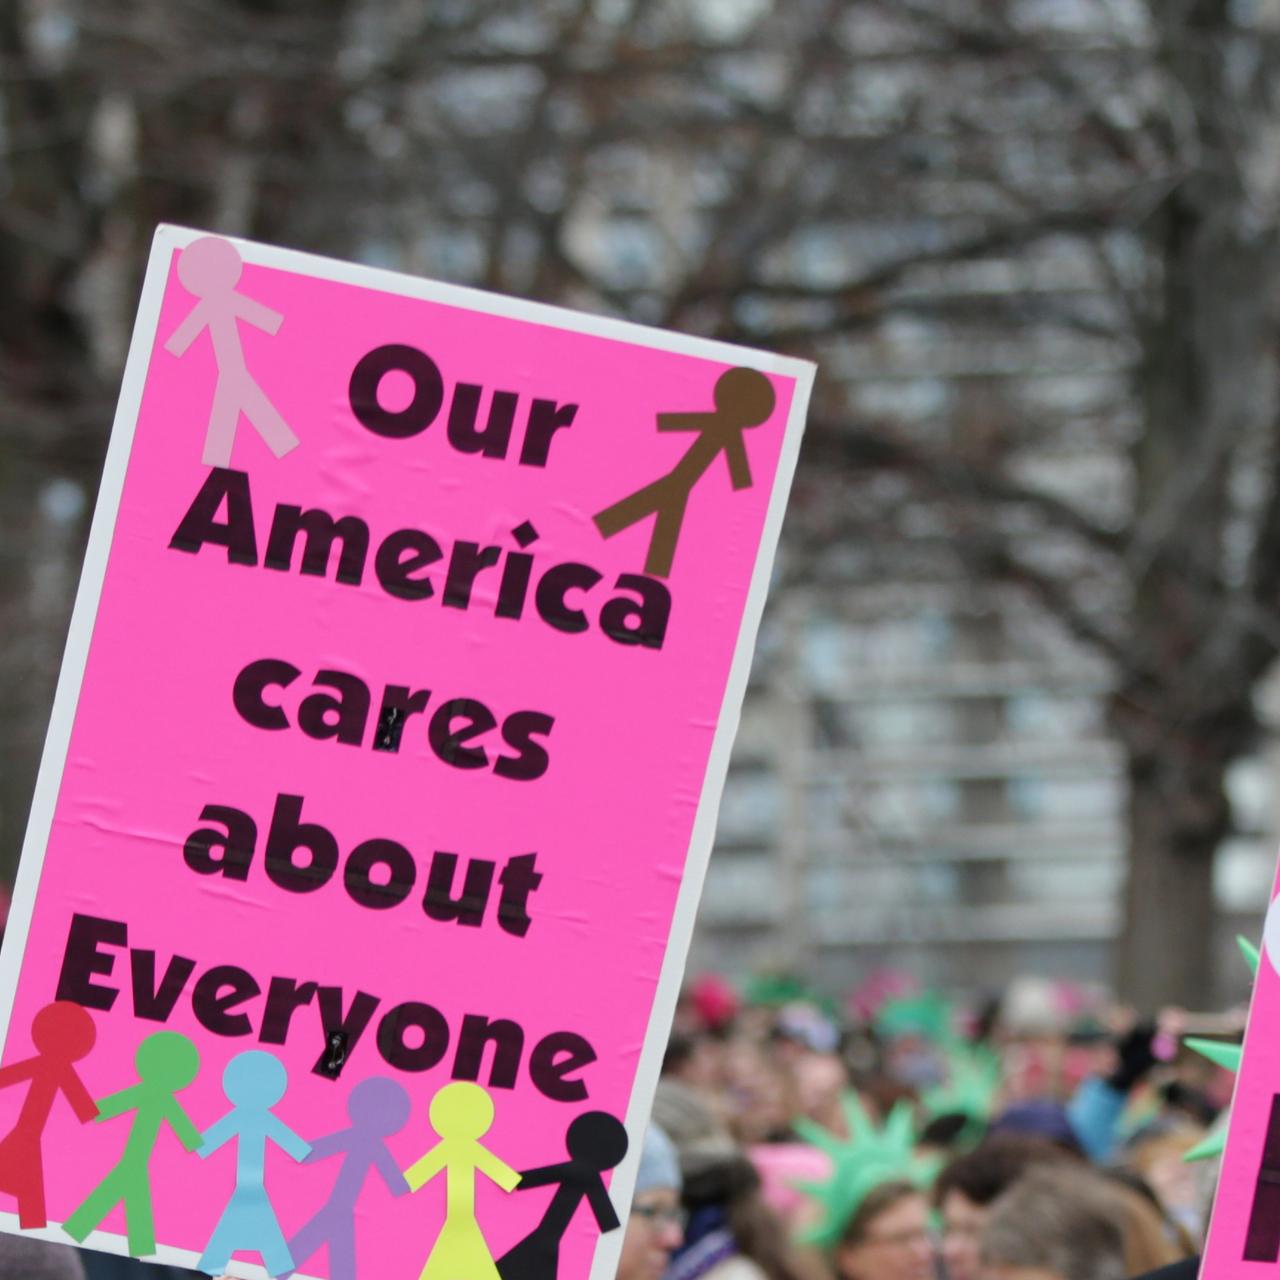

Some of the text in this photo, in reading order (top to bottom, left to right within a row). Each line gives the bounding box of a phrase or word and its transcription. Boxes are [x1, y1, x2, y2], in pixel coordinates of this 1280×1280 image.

[348, 343, 578, 468] Our
[168, 466, 672, 650] America
[232, 658, 554, 782] cares
[182, 793, 543, 937] about
[55, 913, 598, 1103] Everyone
